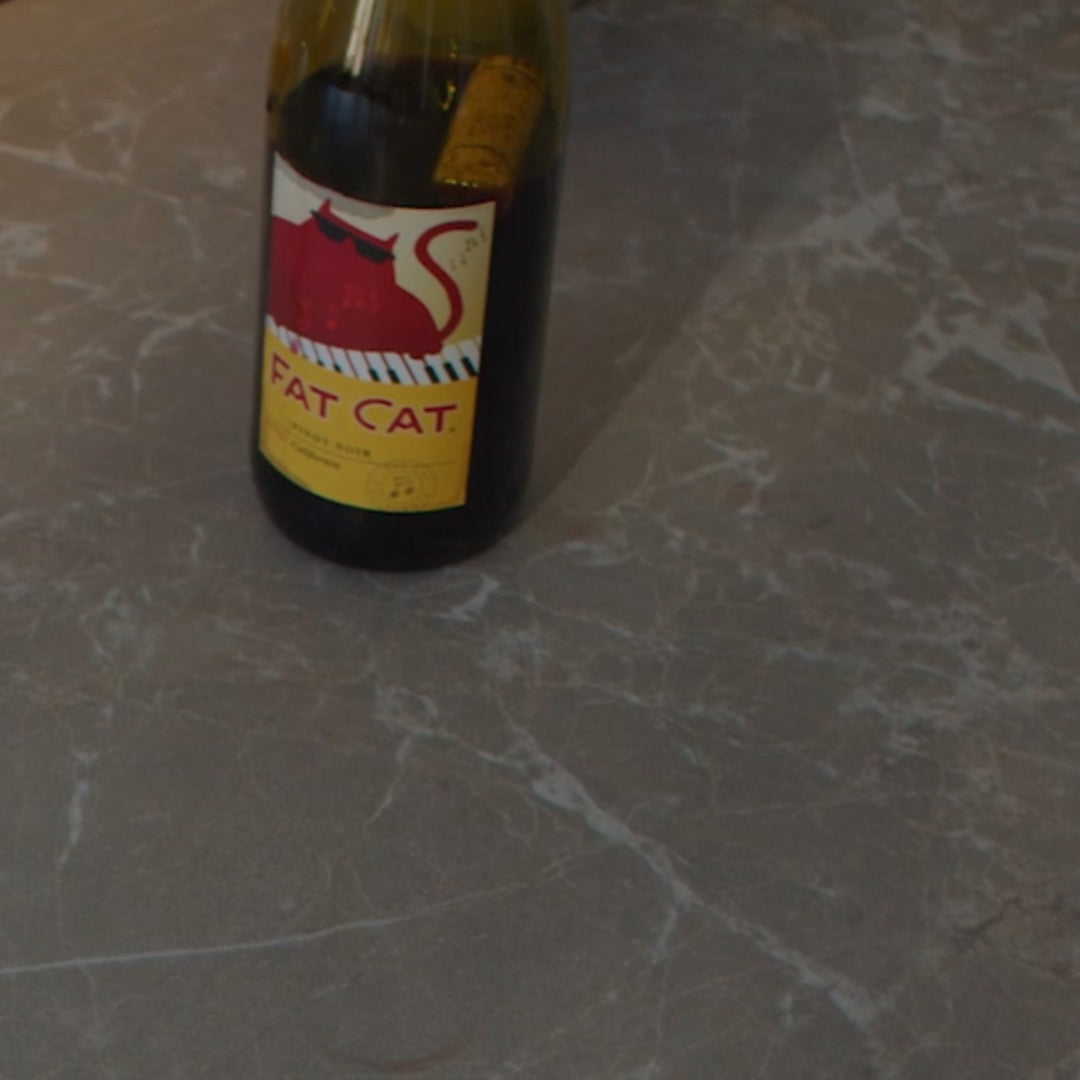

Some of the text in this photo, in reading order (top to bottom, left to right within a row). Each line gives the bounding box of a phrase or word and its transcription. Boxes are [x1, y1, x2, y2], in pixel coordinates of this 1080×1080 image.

[271, 352, 457, 434] FAT CAT
[291, 422, 372, 457] PINOT NOIR
